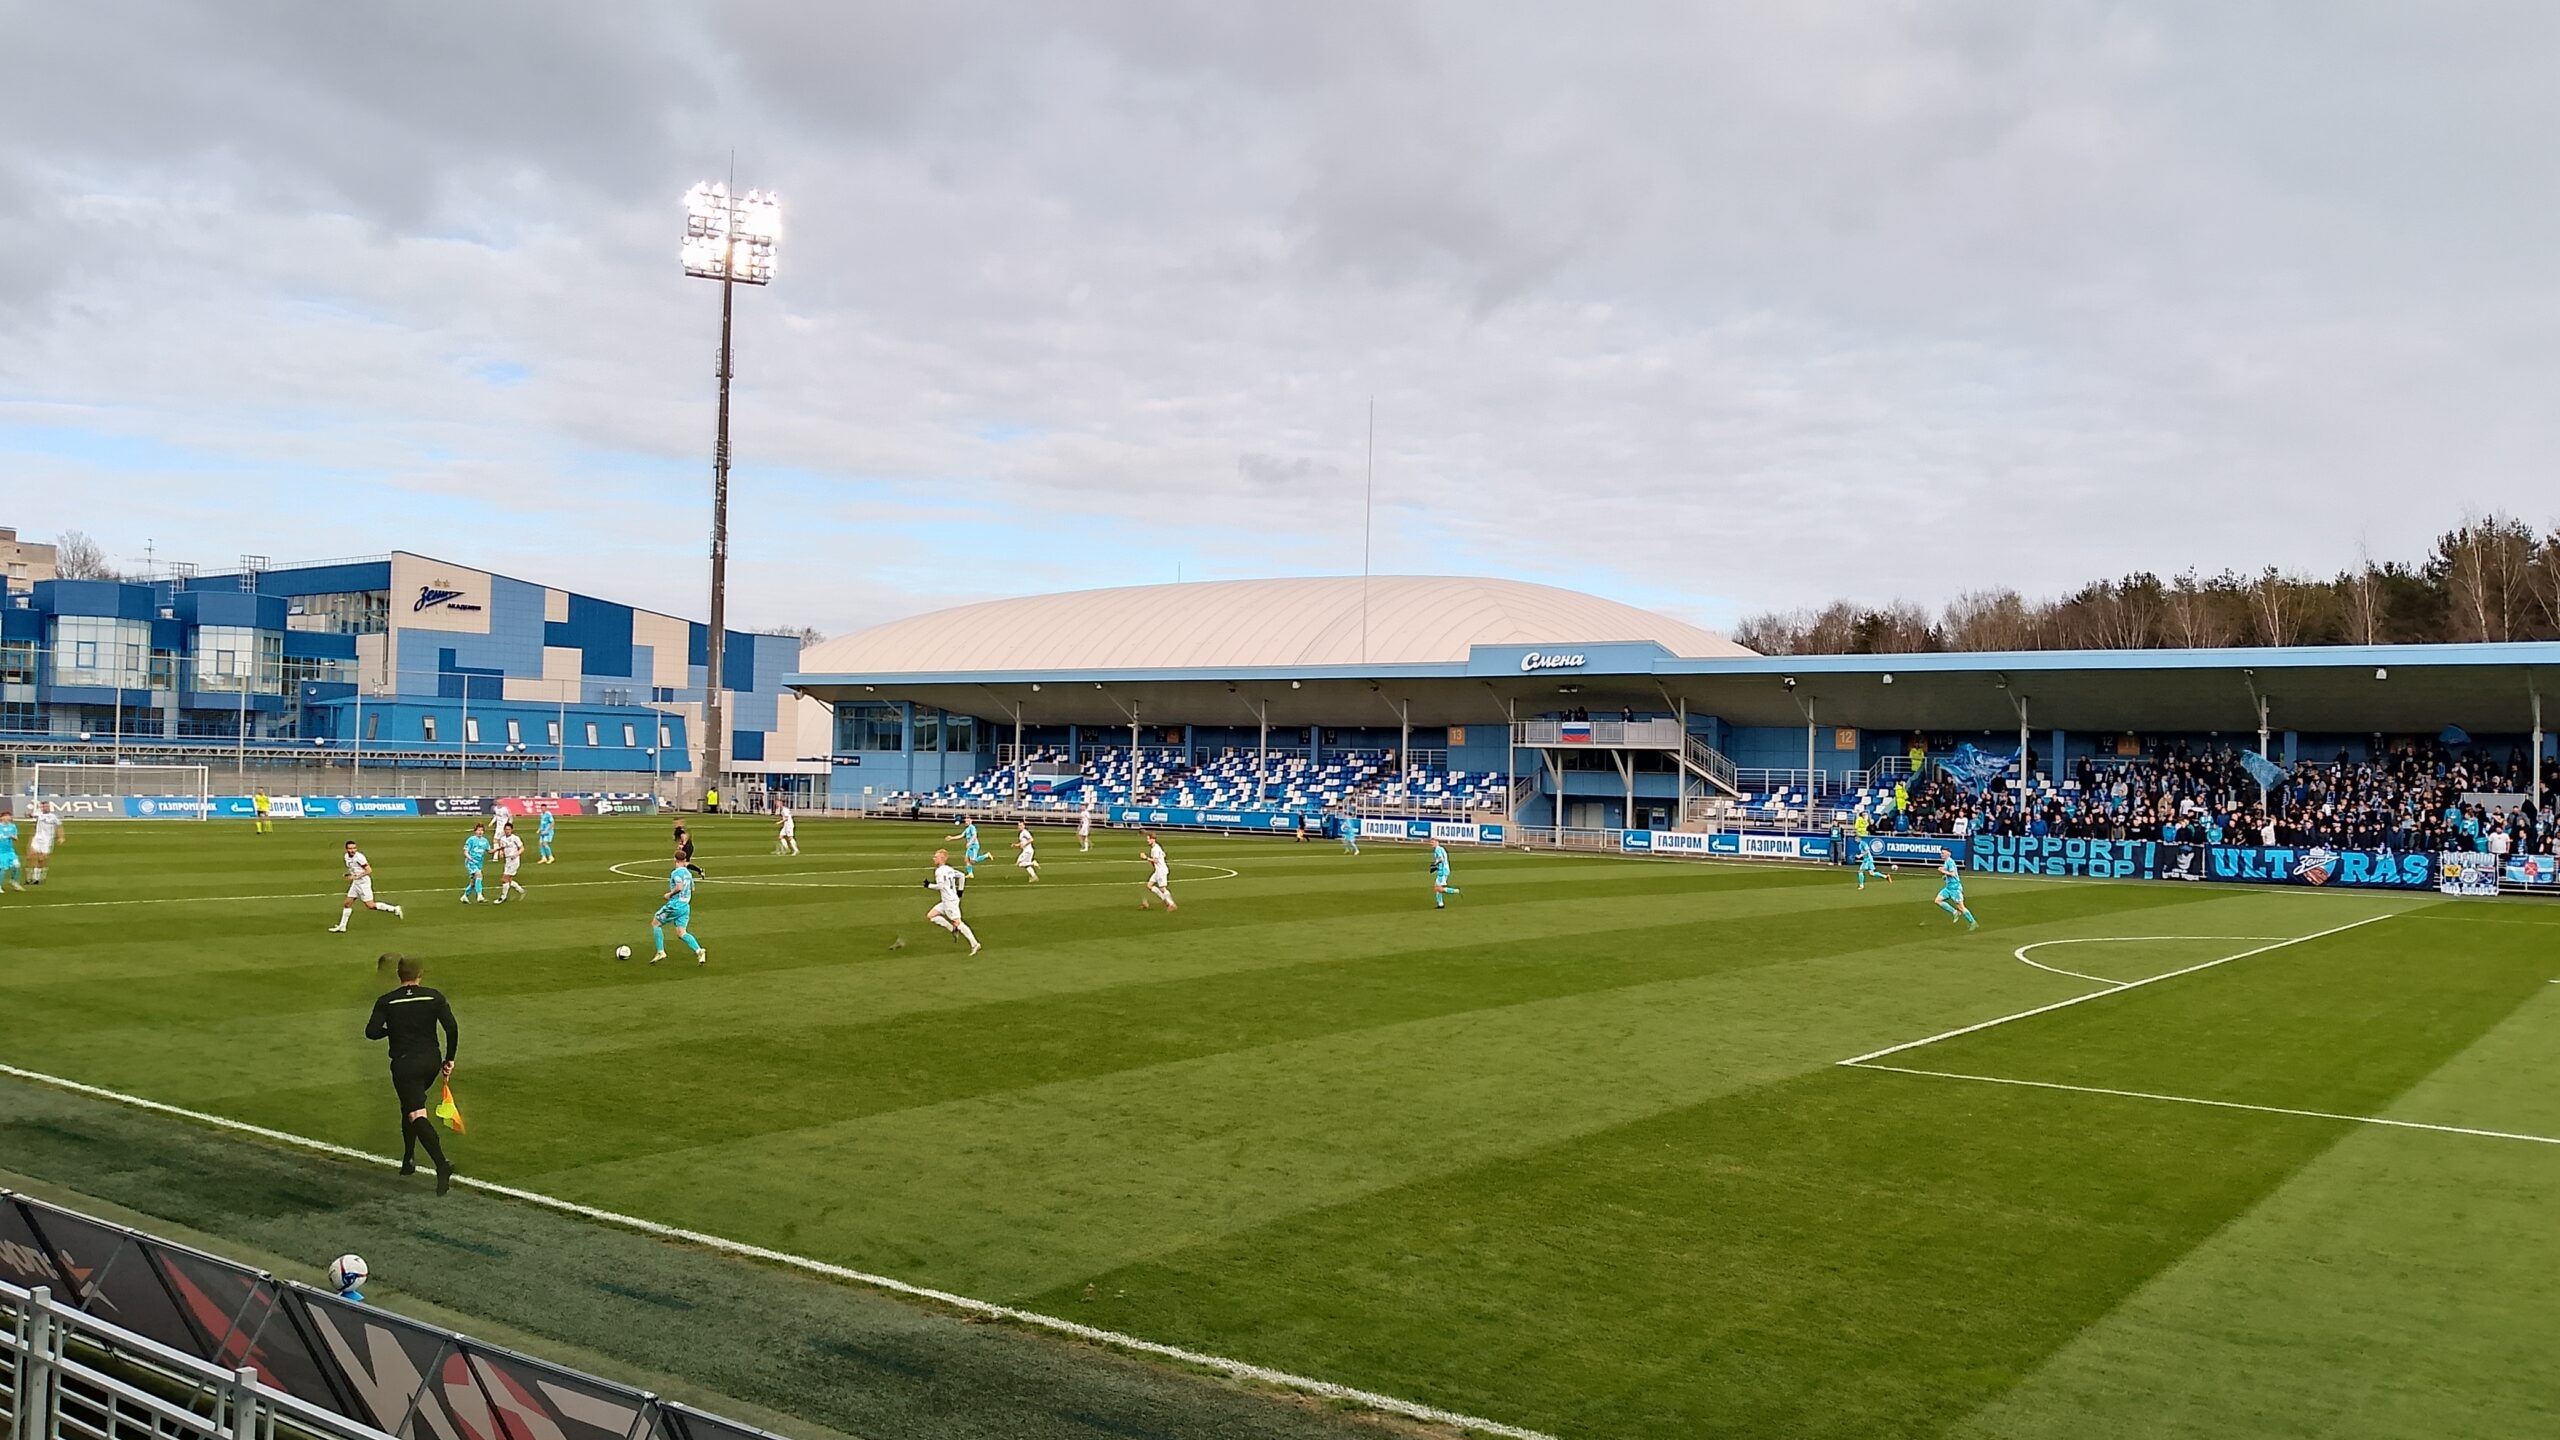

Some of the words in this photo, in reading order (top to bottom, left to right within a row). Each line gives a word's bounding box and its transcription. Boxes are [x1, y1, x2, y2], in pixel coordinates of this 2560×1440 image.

[1521, 652, 1586, 671] Смена
[1451, 729, 1462, 740] 13
[1840, 732, 1853, 743] 12
[2102, 736, 2113, 746] 12
[2145, 736, 2157, 747] 10
[1366, 822, 1402, 835] ГАЗПРОМ
[1436, 825, 1474, 838] ГАЗПРОМ
[1658, 835, 1702, 849] ГАЗПРОМ
[1746, 839, 1793, 853] ГАЗПРОМ
[1886, 843, 1942, 854] ГАЗПРОМБАНК
[1973, 835, 2141, 860] SUPPORT
[2211, 847, 2293, 879] ULT
[2340, 852, 2429, 884] RAS
